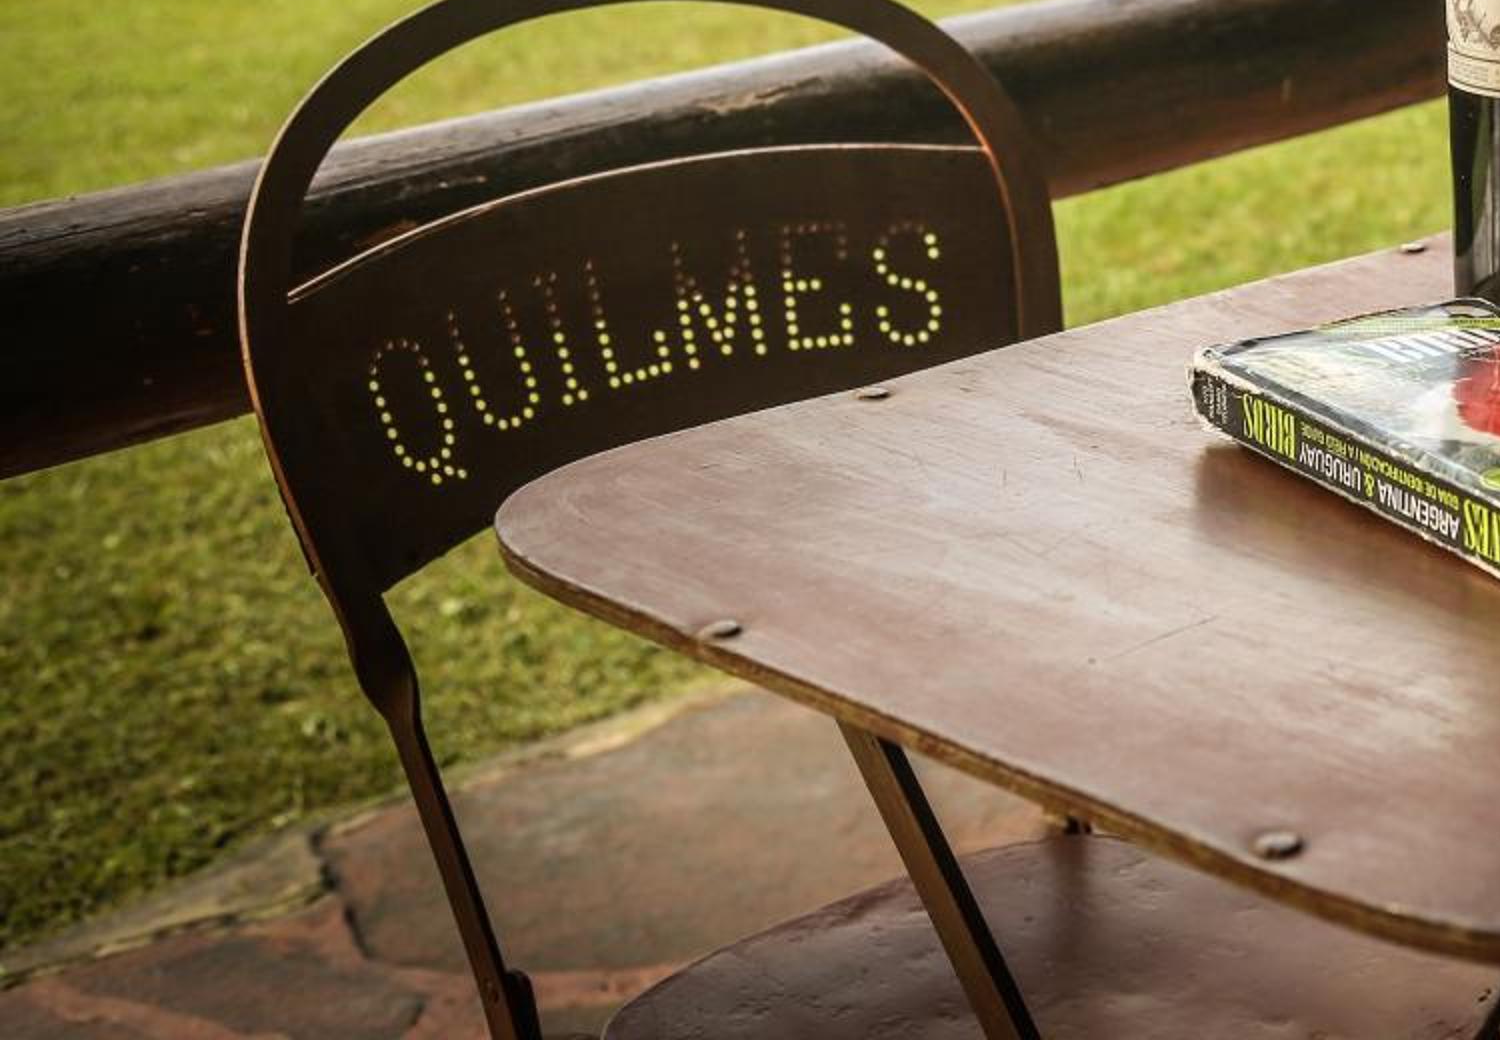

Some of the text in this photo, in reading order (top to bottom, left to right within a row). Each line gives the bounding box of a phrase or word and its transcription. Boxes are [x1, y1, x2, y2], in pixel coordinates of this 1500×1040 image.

[368, 222, 941, 485] QUILMES
[1243, 393, 1296, 461] BIRDS
[1299, 441, 1361, 493] URUGUAY
[1363, 471, 1375, 497] &
[1377, 479, 1460, 541] ARGENTINA
